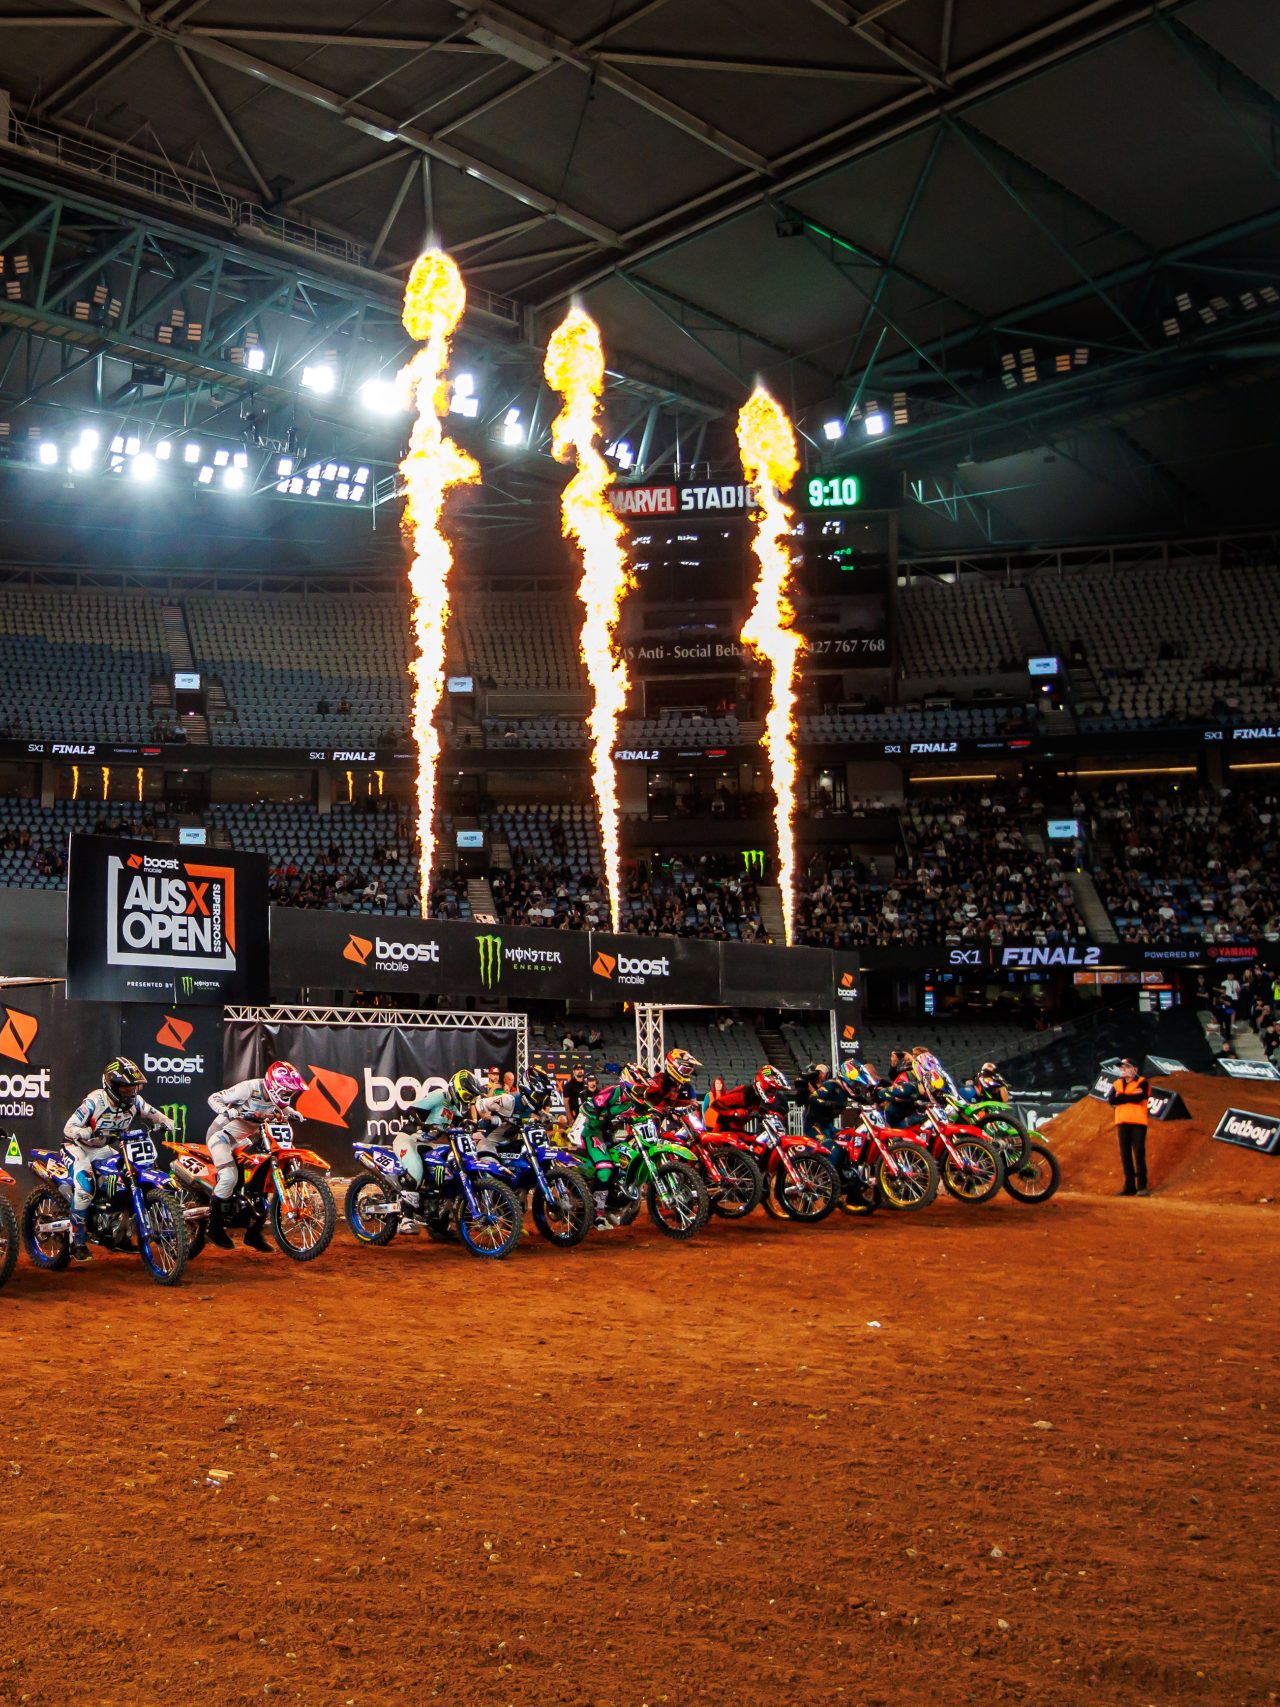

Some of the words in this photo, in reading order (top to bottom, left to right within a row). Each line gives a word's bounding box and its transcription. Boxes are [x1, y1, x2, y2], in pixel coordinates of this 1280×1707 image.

[608, 488, 675, 514] MARVEL
[681, 485, 764, 511] STADIU
[809, 478, 858, 507] 9:10
[637, 645, 664, 660] Anti
[674, 643, 711, 659] Social
[716, 642, 743, 657] Beh
[834, 640, 857, 653] 767
[861, 638, 886, 651] 768
[1204, 731, 1223, 740] SX1
[28, 744, 44, 752] SX1
[884, 745, 901, 753] SX1
[309, 752, 325, 760] SX1
[143, 855, 179, 870] boost
[123, 875, 211, 916] AUSX
[212, 883, 222, 953] SUPERCROSS
[122, 911, 212, 953] OPEN
[375, 936, 440, 963] boost
[505, 946, 563, 964] MONSTER
[949, 949, 982, 965] SX1
[1144, 951, 1184, 959] POWERED
[1187, 951, 1201, 959] BY
[1219, 947, 1258, 957] YAMAHA
[375, 961, 409, 972] mobile
[513, 963, 552, 973] ENERGY
[617, 953, 669, 977] boost
[193, 980, 221, 988] MONSTER
[618, 974, 645, 985] mobile
[837, 987, 858, 997] boost
[840, 1040, 859, 1049] boost
[144, 1053, 204, 1074] boost
[157, 1074, 192, 1085] mobile
[271, 1127, 292, 1142] 53
[1223, 1116, 1272, 1146] fatboy
[130, 1142, 154, 1162] 29
[375, 1155, 393, 1167] 86
